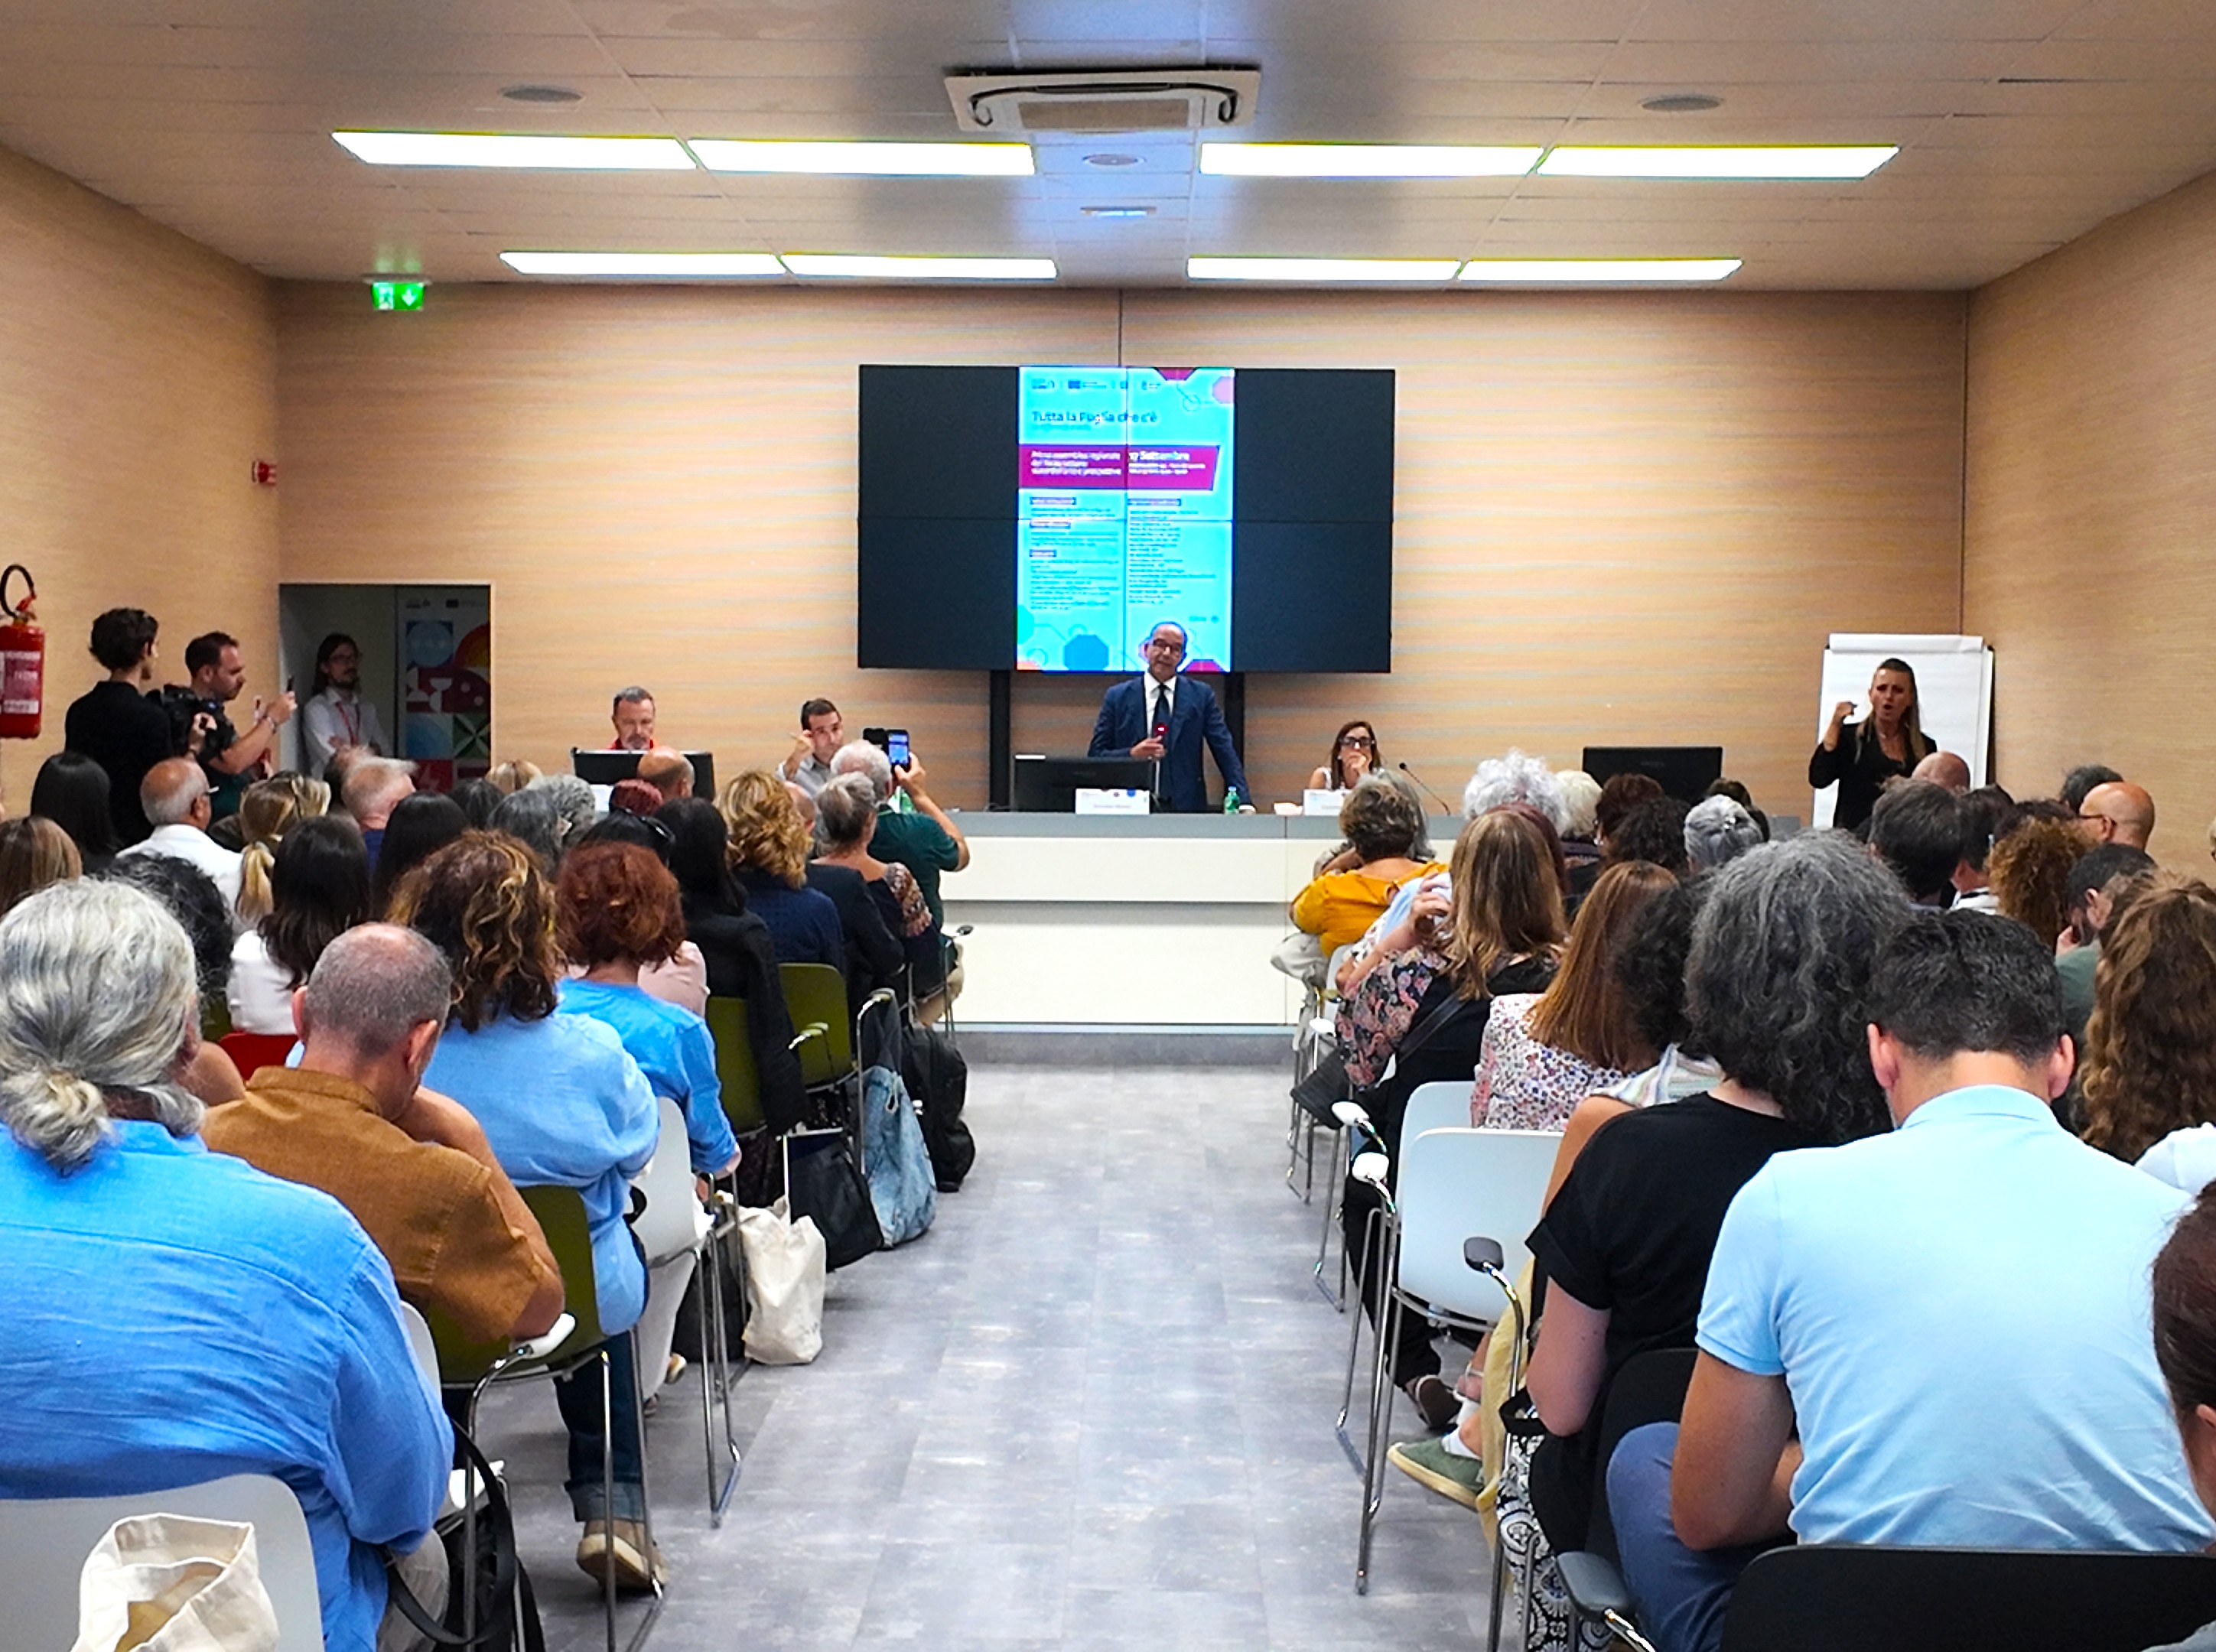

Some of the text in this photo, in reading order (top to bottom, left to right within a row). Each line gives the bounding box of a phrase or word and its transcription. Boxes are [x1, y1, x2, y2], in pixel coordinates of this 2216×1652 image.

[1032, 411, 1063, 421] Tutta
[1066, 411, 1076, 421] la
[1079, 411, 1115, 425] Puglia
